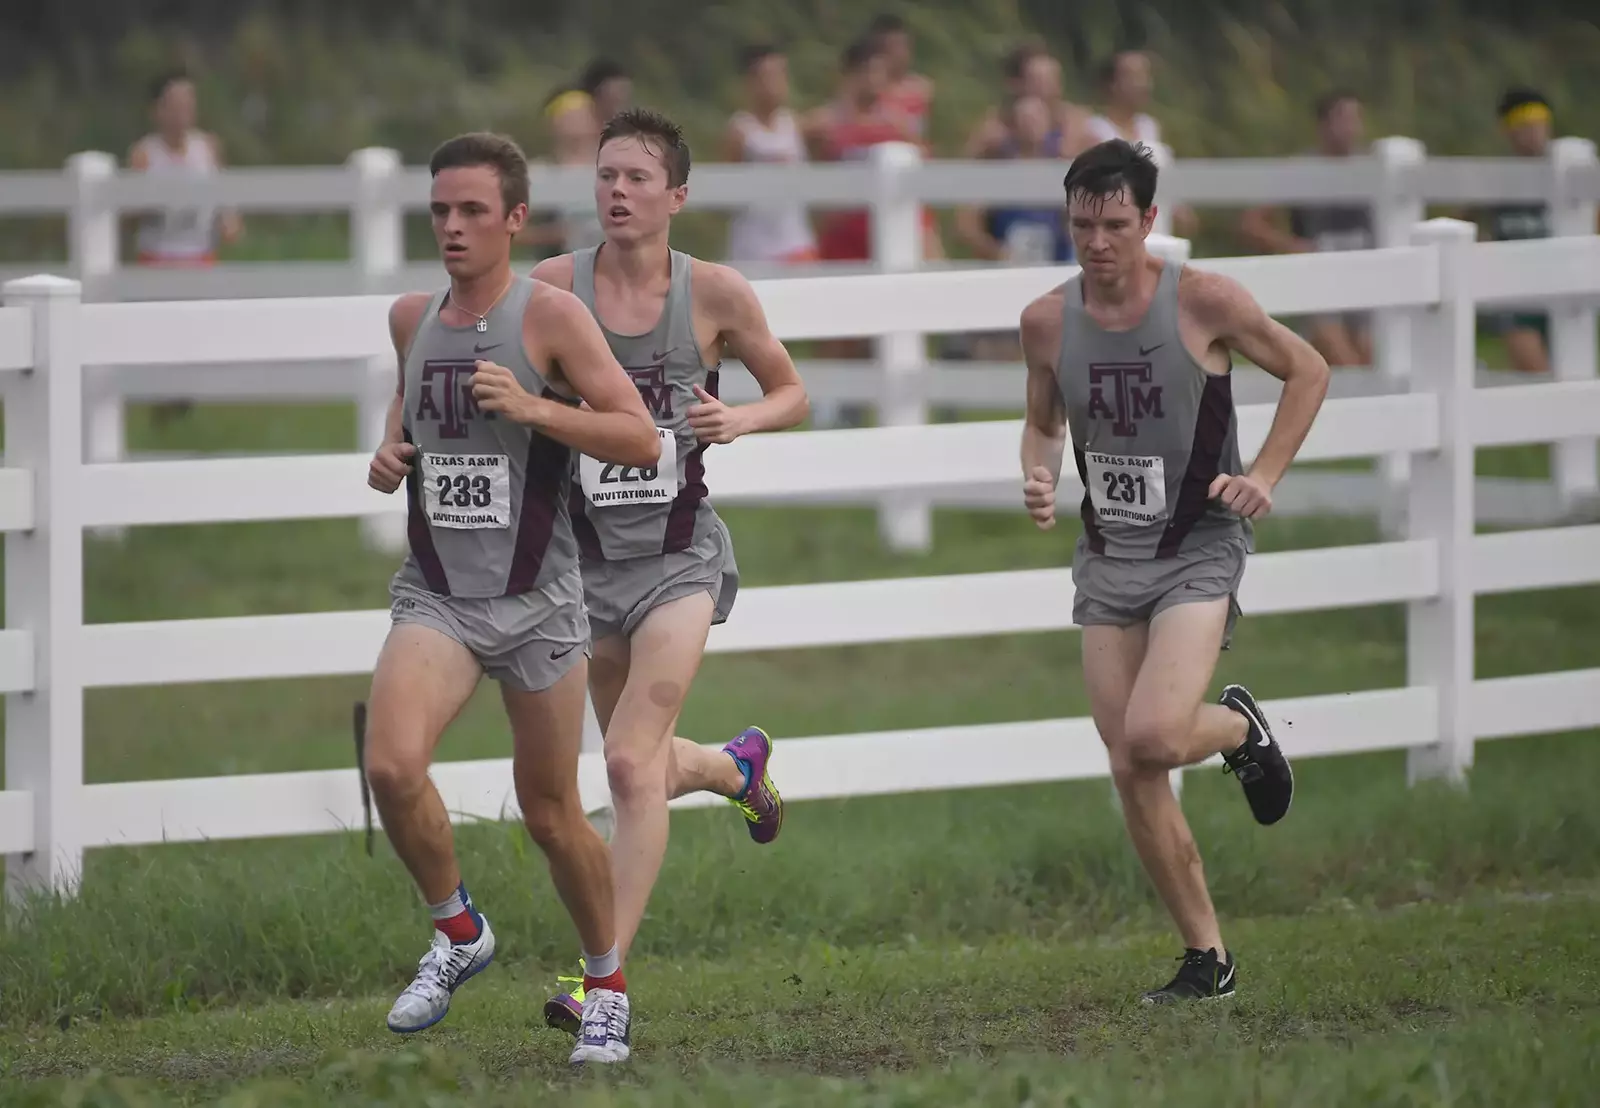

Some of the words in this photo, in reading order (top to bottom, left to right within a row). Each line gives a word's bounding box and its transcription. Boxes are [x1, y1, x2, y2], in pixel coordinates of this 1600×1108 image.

[429, 455, 465, 466] TEXAS
[468, 456, 499, 467] A&M
[1091, 455, 1124, 466] TEXAS
[1128, 457, 1153, 468] A&M
[436, 474, 492, 508] 233
[1102, 471, 1147, 505] 231
[592, 489, 668, 502] INVITATIONAL
[433, 511, 500, 525] INVITATIONAL
